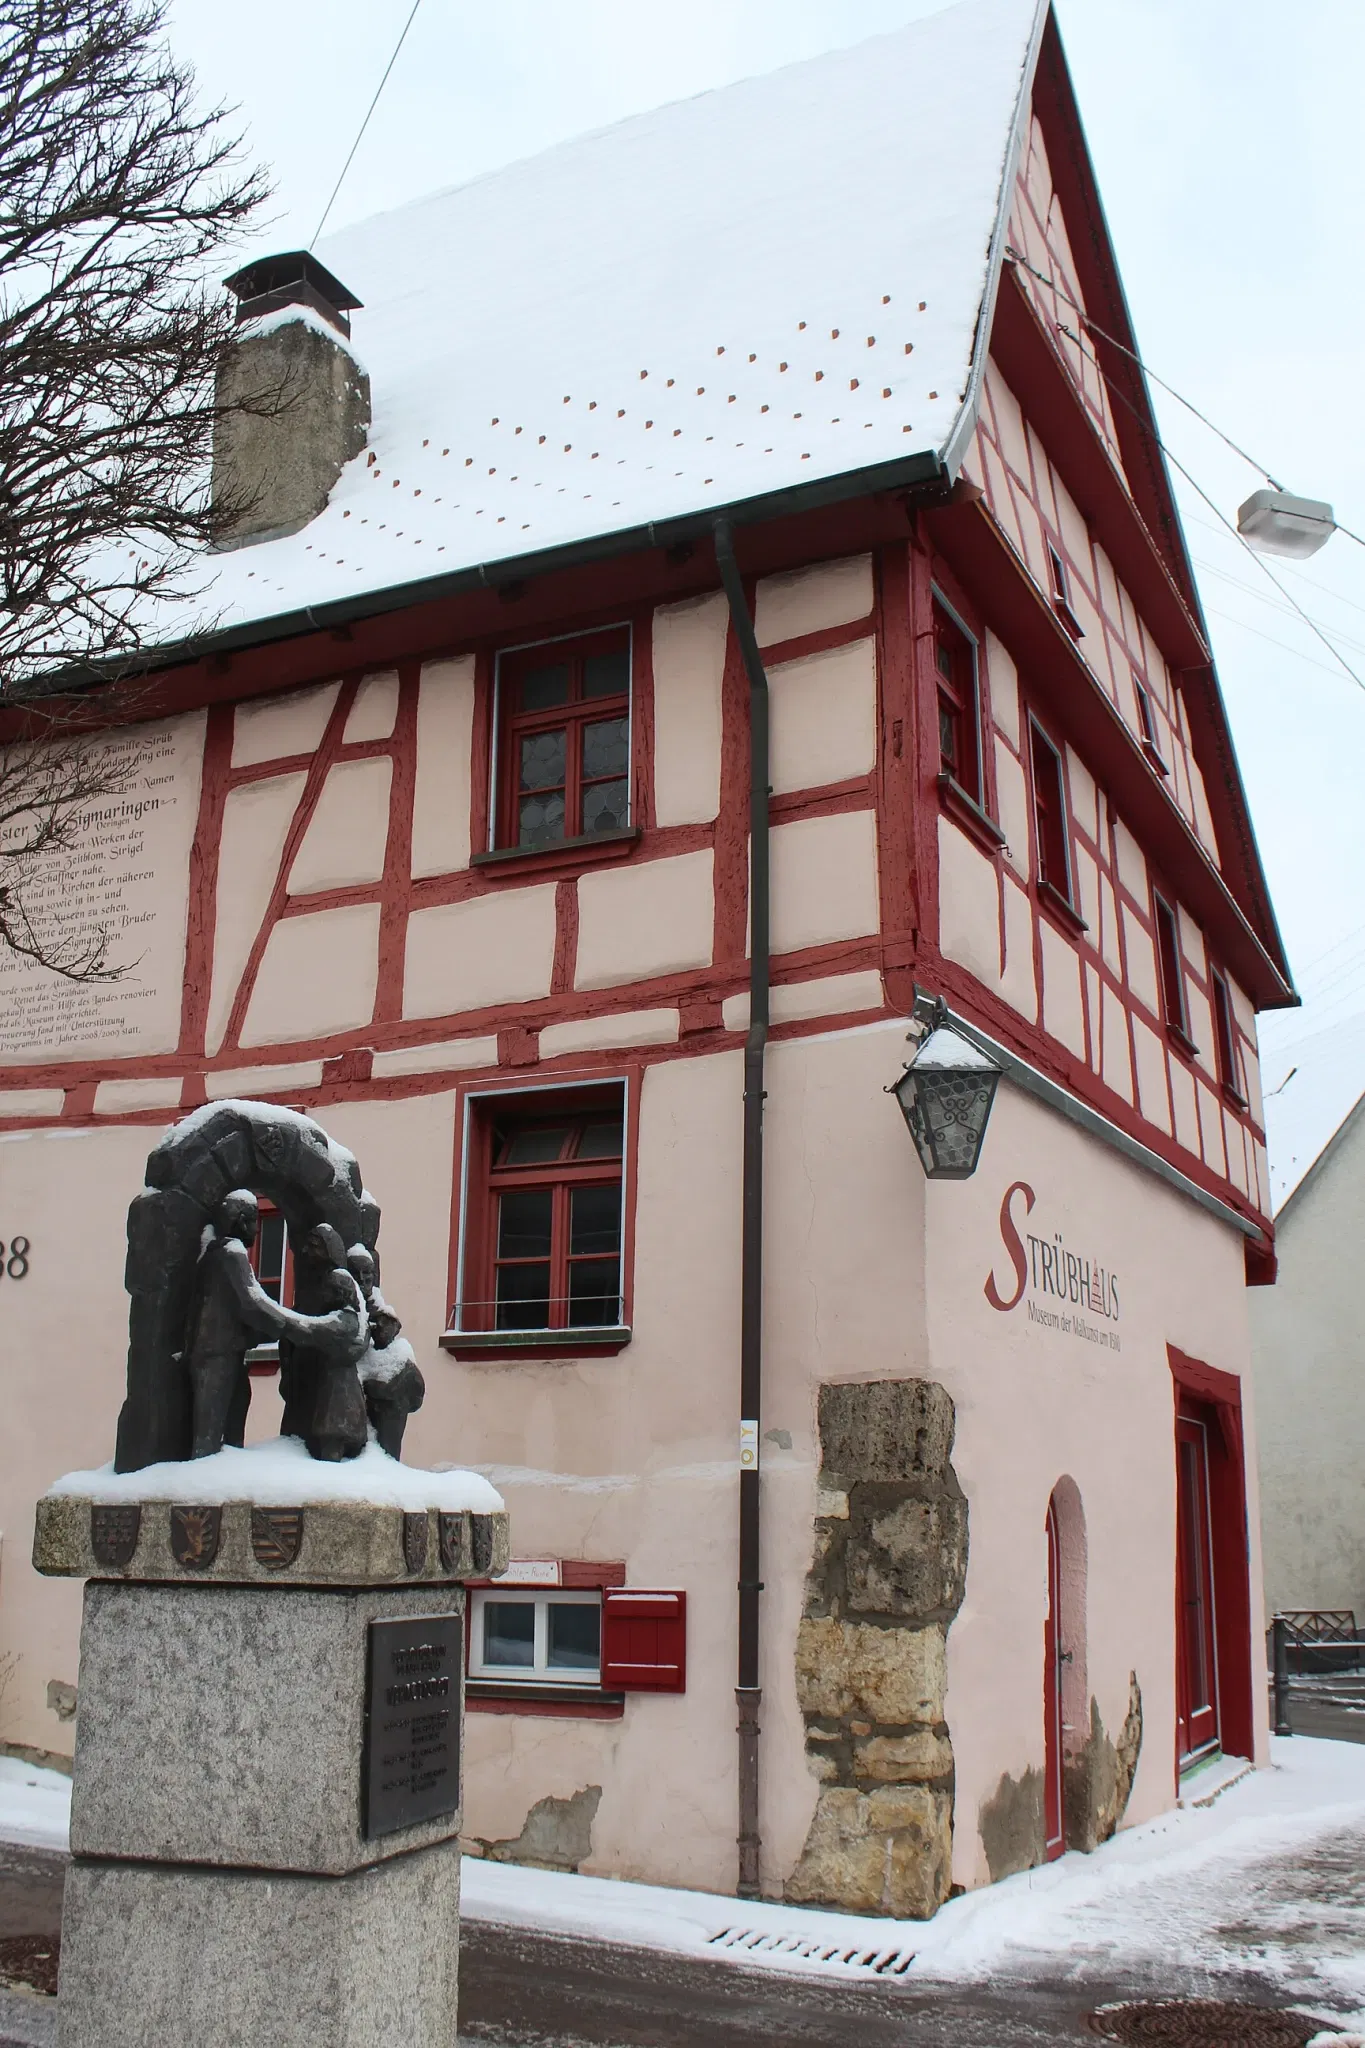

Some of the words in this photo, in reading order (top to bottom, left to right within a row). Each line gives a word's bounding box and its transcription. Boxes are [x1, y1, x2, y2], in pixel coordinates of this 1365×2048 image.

[143, 732, 173, 749] Strüb
[156, 747, 176, 758] eine
[141, 775, 175, 789] Namen
[87, 833, 125, 848] Werken
[128, 829, 144, 841] der
[46, 860, 61, 870] von
[109, 841, 144, 859] Strigel
[27, 887, 44, 900] sind
[47, 886, 55, 897] in
[59, 880, 95, 897] Kirchen
[98, 876, 114, 887] der
[117, 871, 154, 884] näheren
[47, 898, 72, 910] sowie
[75, 895, 83, 905] in
[104, 887, 122, 900] und
[88, 908, 98, 917] zu
[101, 903, 129, 915] sehen.
[58, 924, 77, 935] dem
[119, 911, 157, 928] Bruder
[20, 984, 33, 993] von
[35, 982, 47, 991] der
[27, 1004, 41, 1014] und
[43, 1003, 54, 1012] mit
[78, 997, 90, 1006] des
[120, 987, 157, 1001] renoviert
[37, 993, 50, 1002] das
[10, 1018, 20, 1028] als
[22, 1014, 54, 1028] Museum
[36, 1024, 54, 1038] fand
[56, 1022, 67, 1032] mit
[70, 1017, 125, 1032] Unterstützung
[44, 1036, 53, 1045] im
[55, 1031, 78, 1047] Jahre
[1027, 1299, 1060, 1330] Museum
[1061, 1311, 1072, 1333] der
